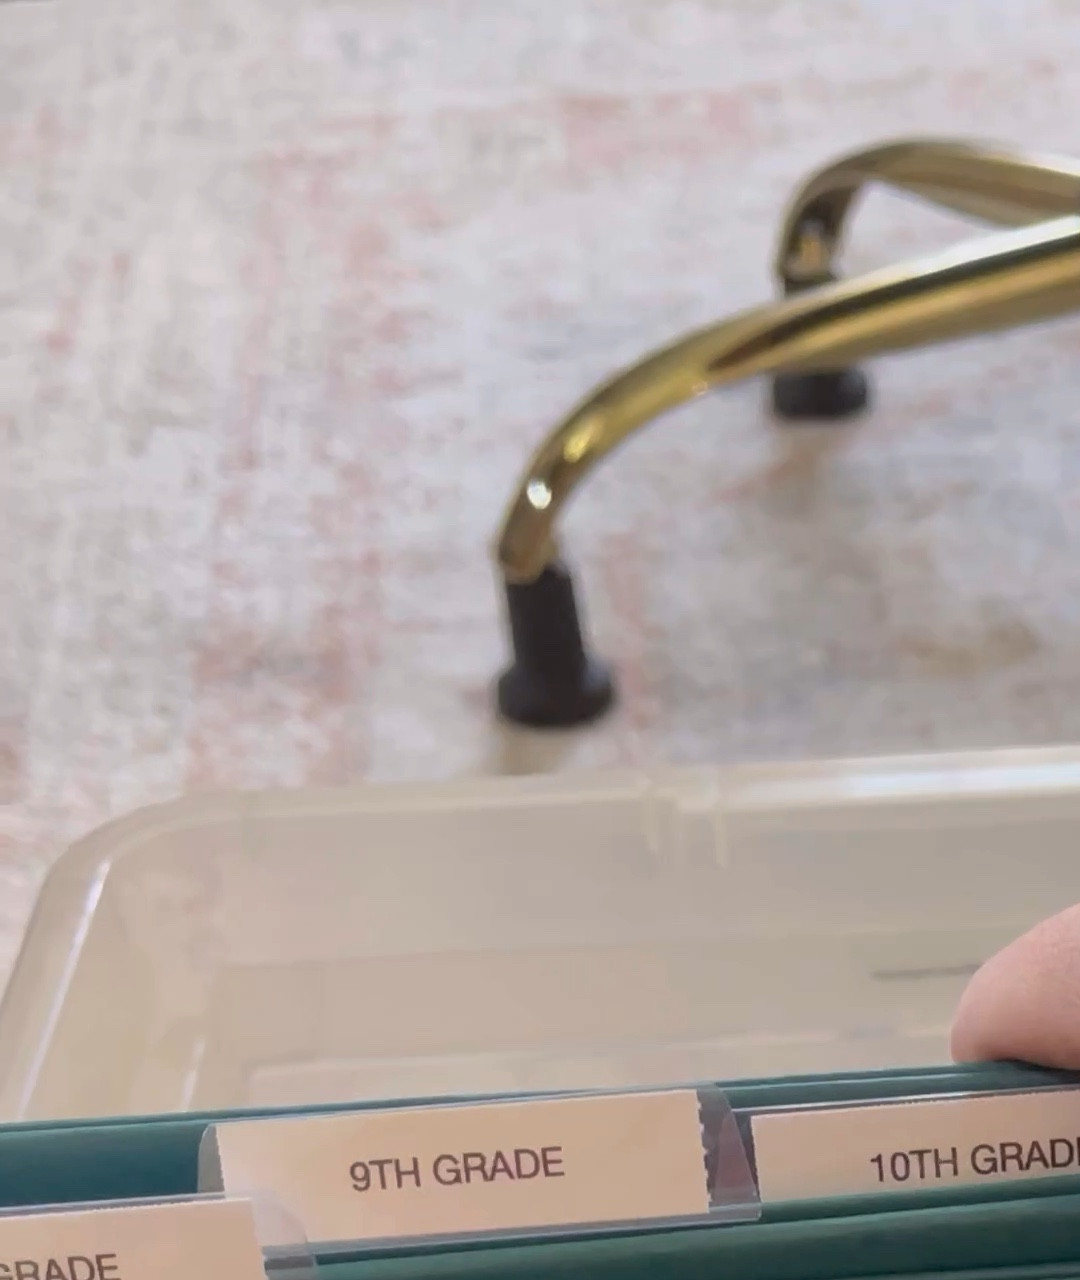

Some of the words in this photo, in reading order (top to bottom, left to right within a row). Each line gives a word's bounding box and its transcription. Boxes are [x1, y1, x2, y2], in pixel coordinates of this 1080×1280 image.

[349, 1156, 421, 1192] 9TH
[432, 1146, 565, 1186] GRADE
[870, 1147, 960, 1183] 10TH
